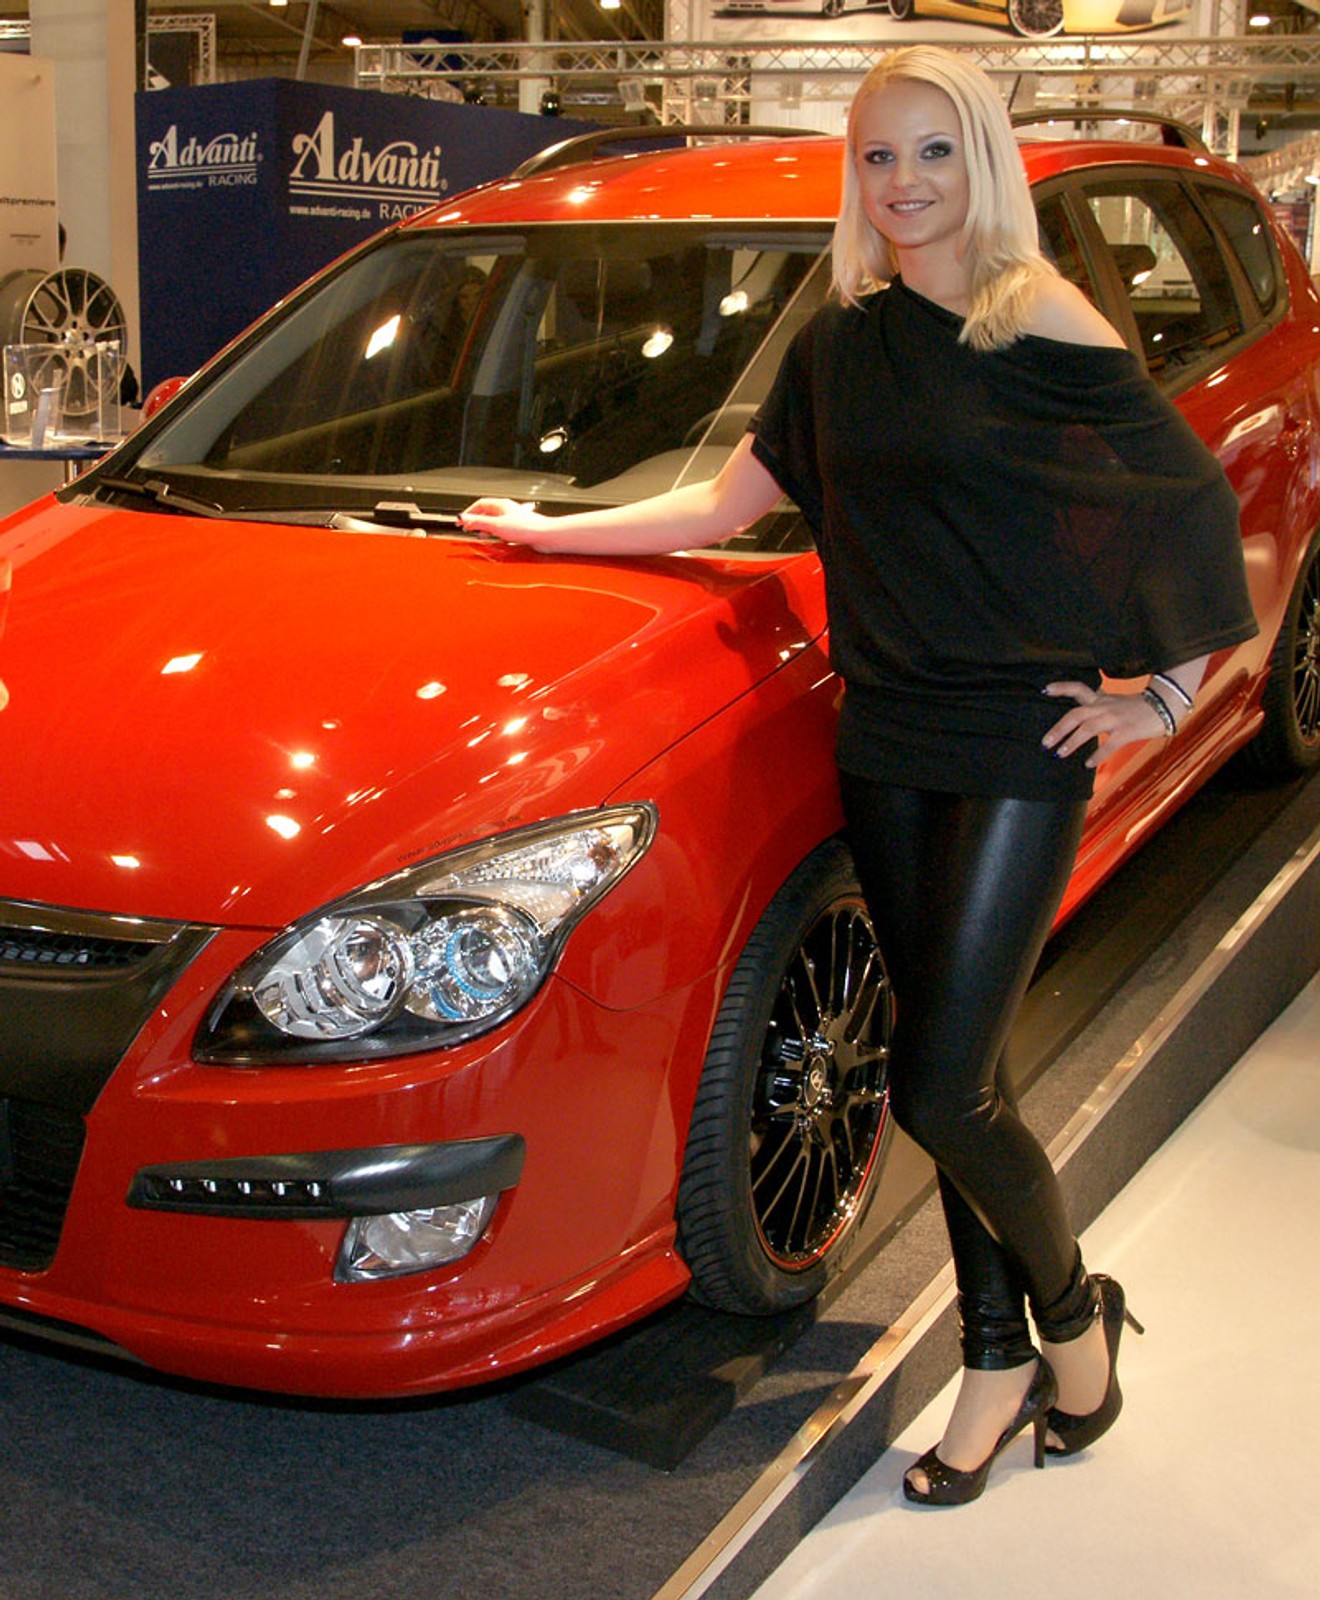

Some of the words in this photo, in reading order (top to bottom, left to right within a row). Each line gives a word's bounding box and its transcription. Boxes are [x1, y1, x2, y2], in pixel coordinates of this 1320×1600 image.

[148, 124, 257, 168] Advanti
[290, 110, 441, 188] Advanti
[208, 173, 257, 186] RACING
